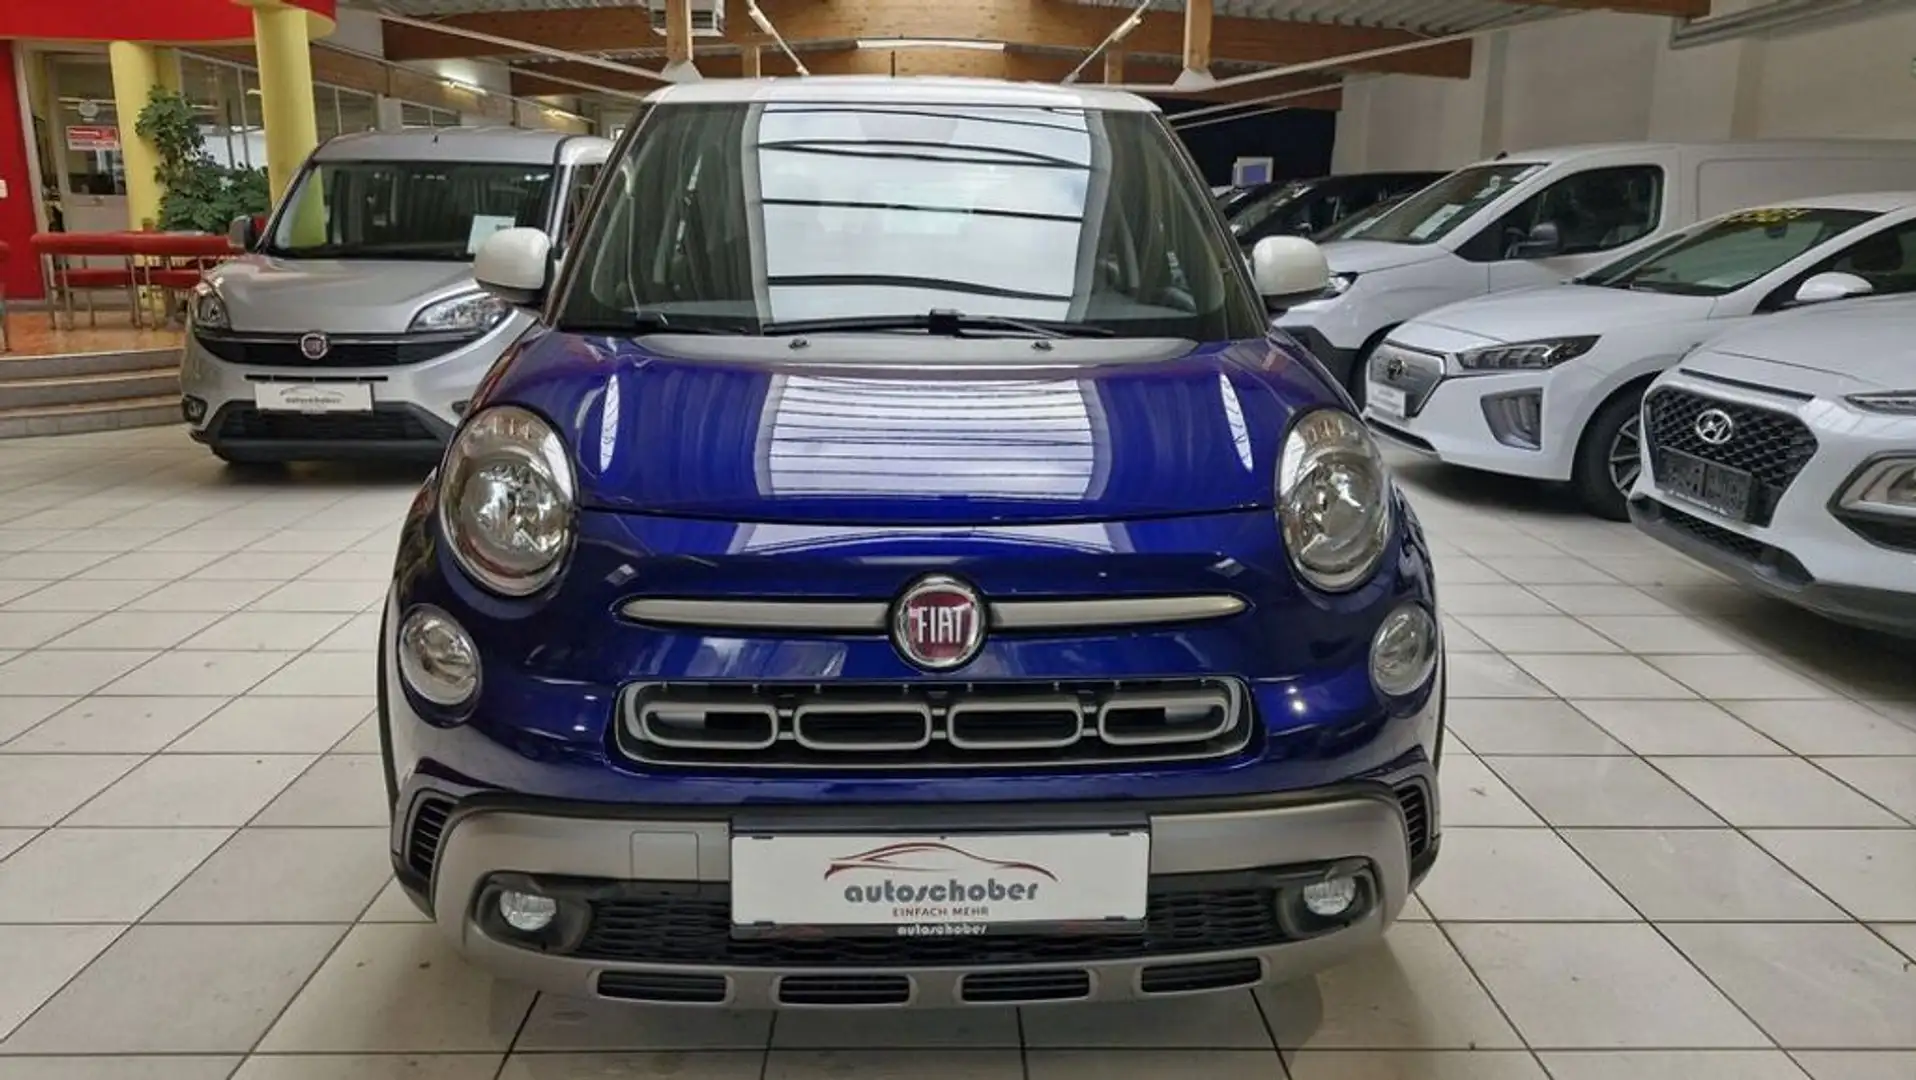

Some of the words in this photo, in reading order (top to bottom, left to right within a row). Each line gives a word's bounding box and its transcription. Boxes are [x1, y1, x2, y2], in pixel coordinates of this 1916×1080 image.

[918, 602, 971, 643] FIAT
[844, 878, 1039, 903] autoschober
[893, 907, 948, 917] EINFACH
[952, 906, 989, 916] MEHR
[897, 923, 988, 936] autoschober
